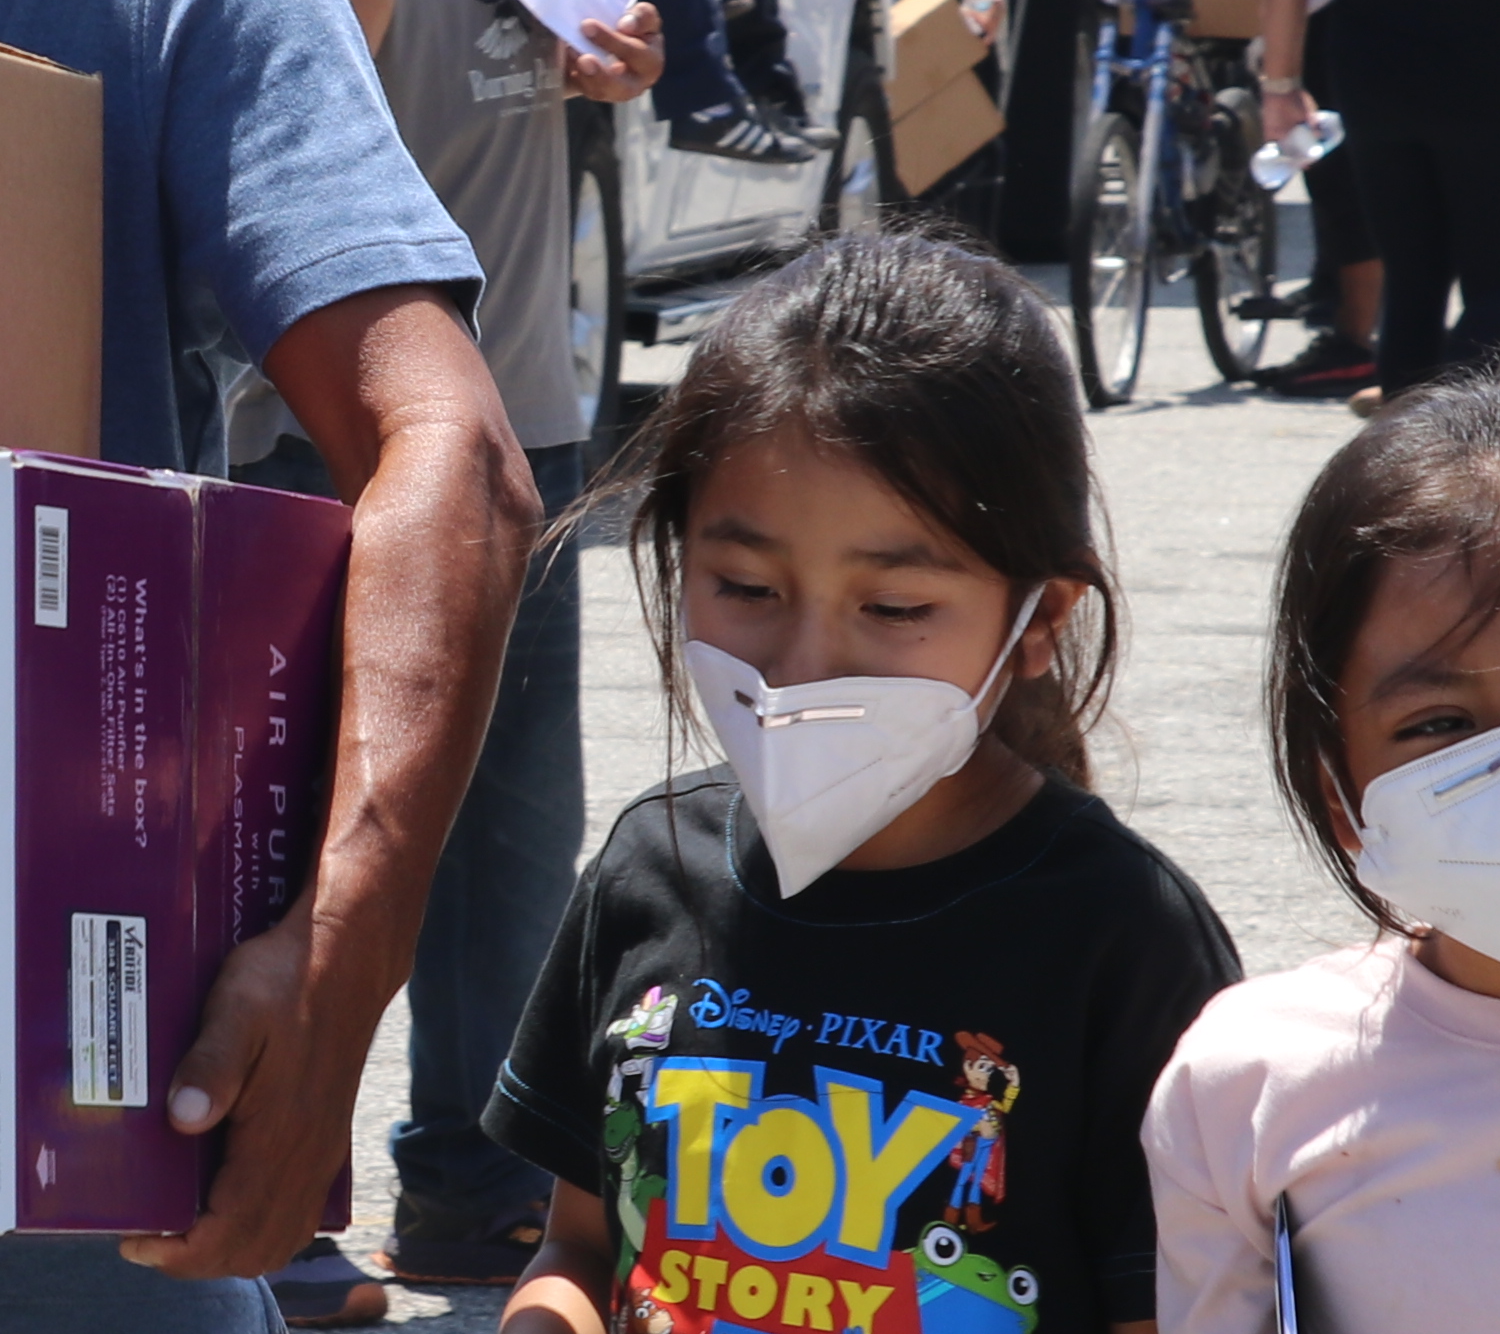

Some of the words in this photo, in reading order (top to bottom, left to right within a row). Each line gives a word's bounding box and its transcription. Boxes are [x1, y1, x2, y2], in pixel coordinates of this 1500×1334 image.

[115, 575, 126, 604] (1)
[134, 578, 146, 678] What's
[116, 665, 126, 695] Air
[134, 688, 146, 713] in
[267, 643, 286, 746] AIR
[106, 716, 115, 768] Filter
[116, 700, 126, 773] Purifier
[134, 723, 146, 770] the
[106, 773, 116, 817] Sets
[133, 778, 146, 848] box?
[107, 972, 115, 1040] SQUARE
[108, 1044, 116, 1084] FEET
[818, 1012, 944, 1066] PIXAR
[647, 1056, 981, 1268] TOY
